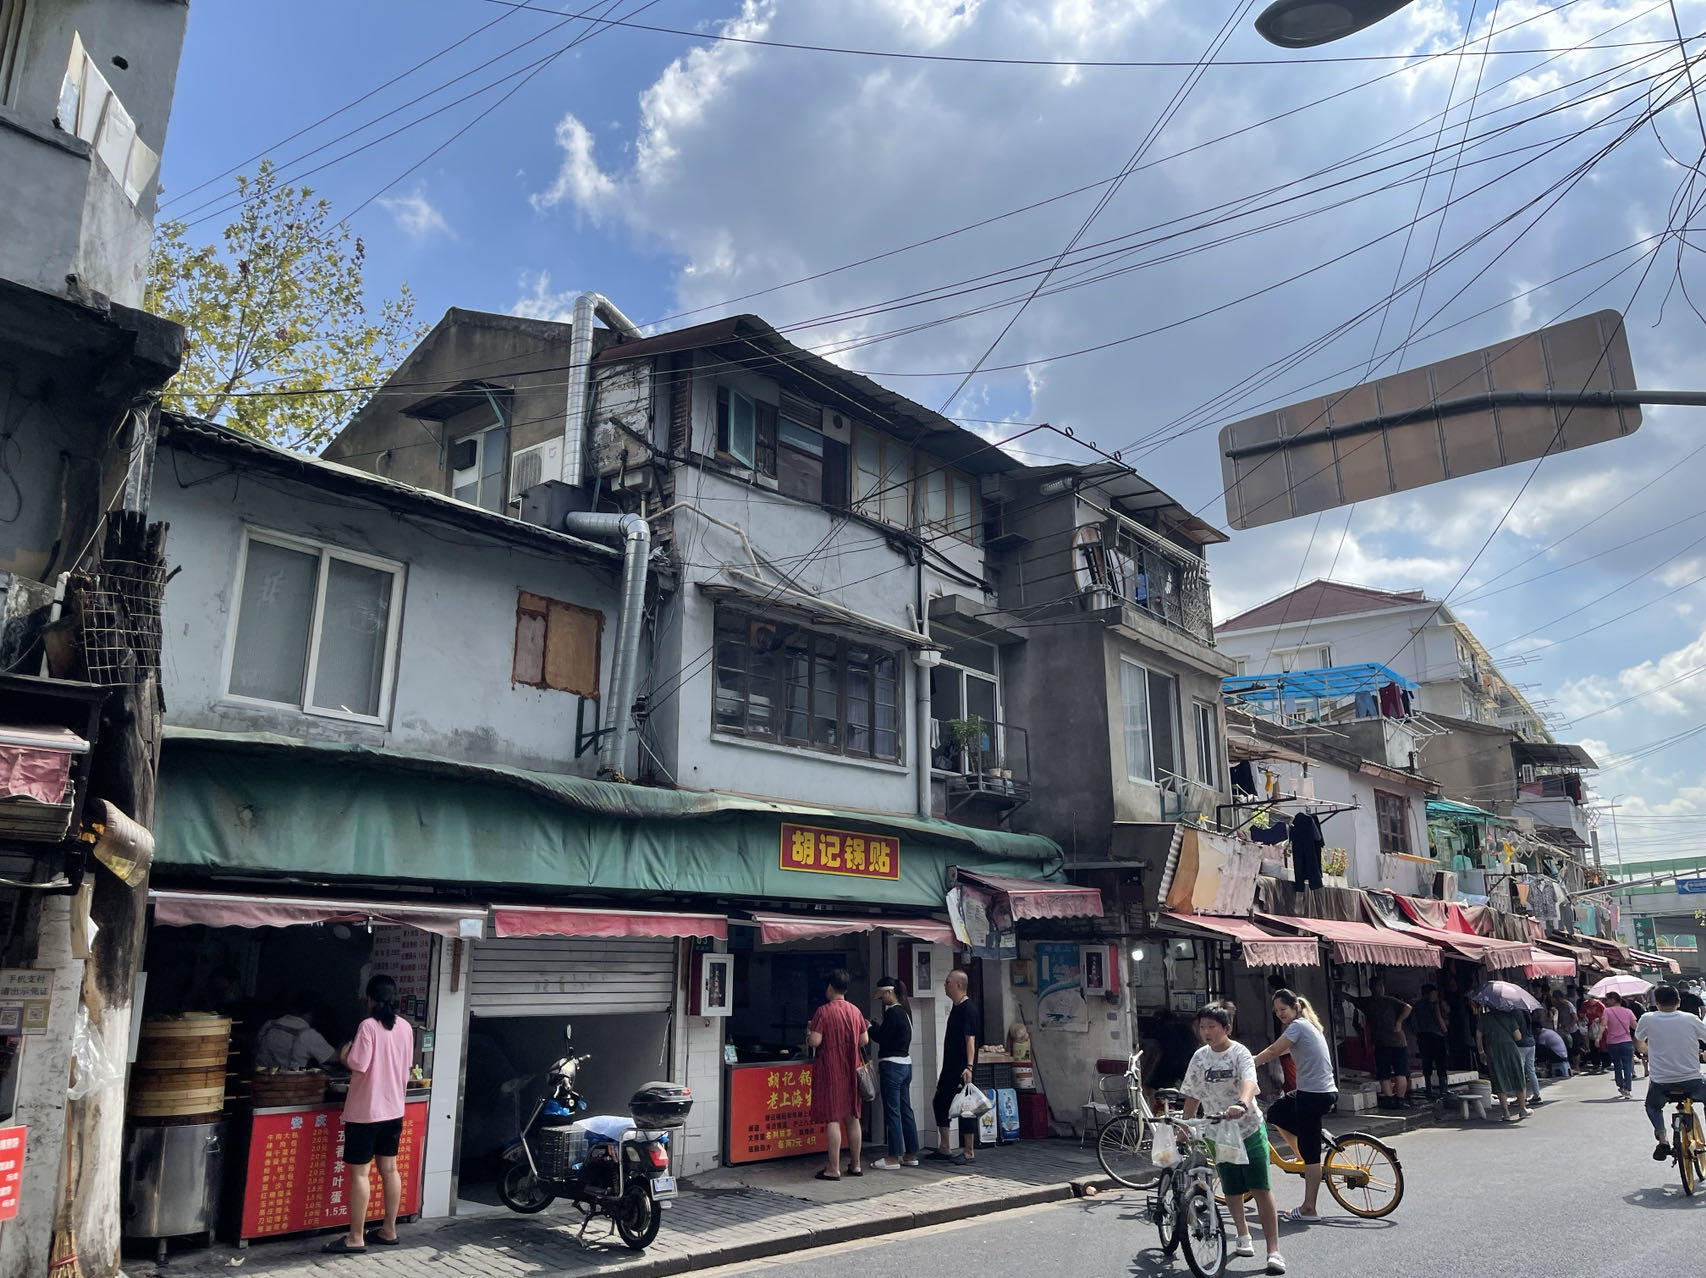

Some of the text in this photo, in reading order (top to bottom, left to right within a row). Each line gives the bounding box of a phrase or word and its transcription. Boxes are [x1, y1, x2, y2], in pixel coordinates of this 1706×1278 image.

[792, 831, 891, 873] 胡记锅贴
[8, 974, 45, 984] 手机支付
[329, 1130, 346, 1204] 五香茶叶蛋
[325, 1205, 348, 1217] 1.5元
